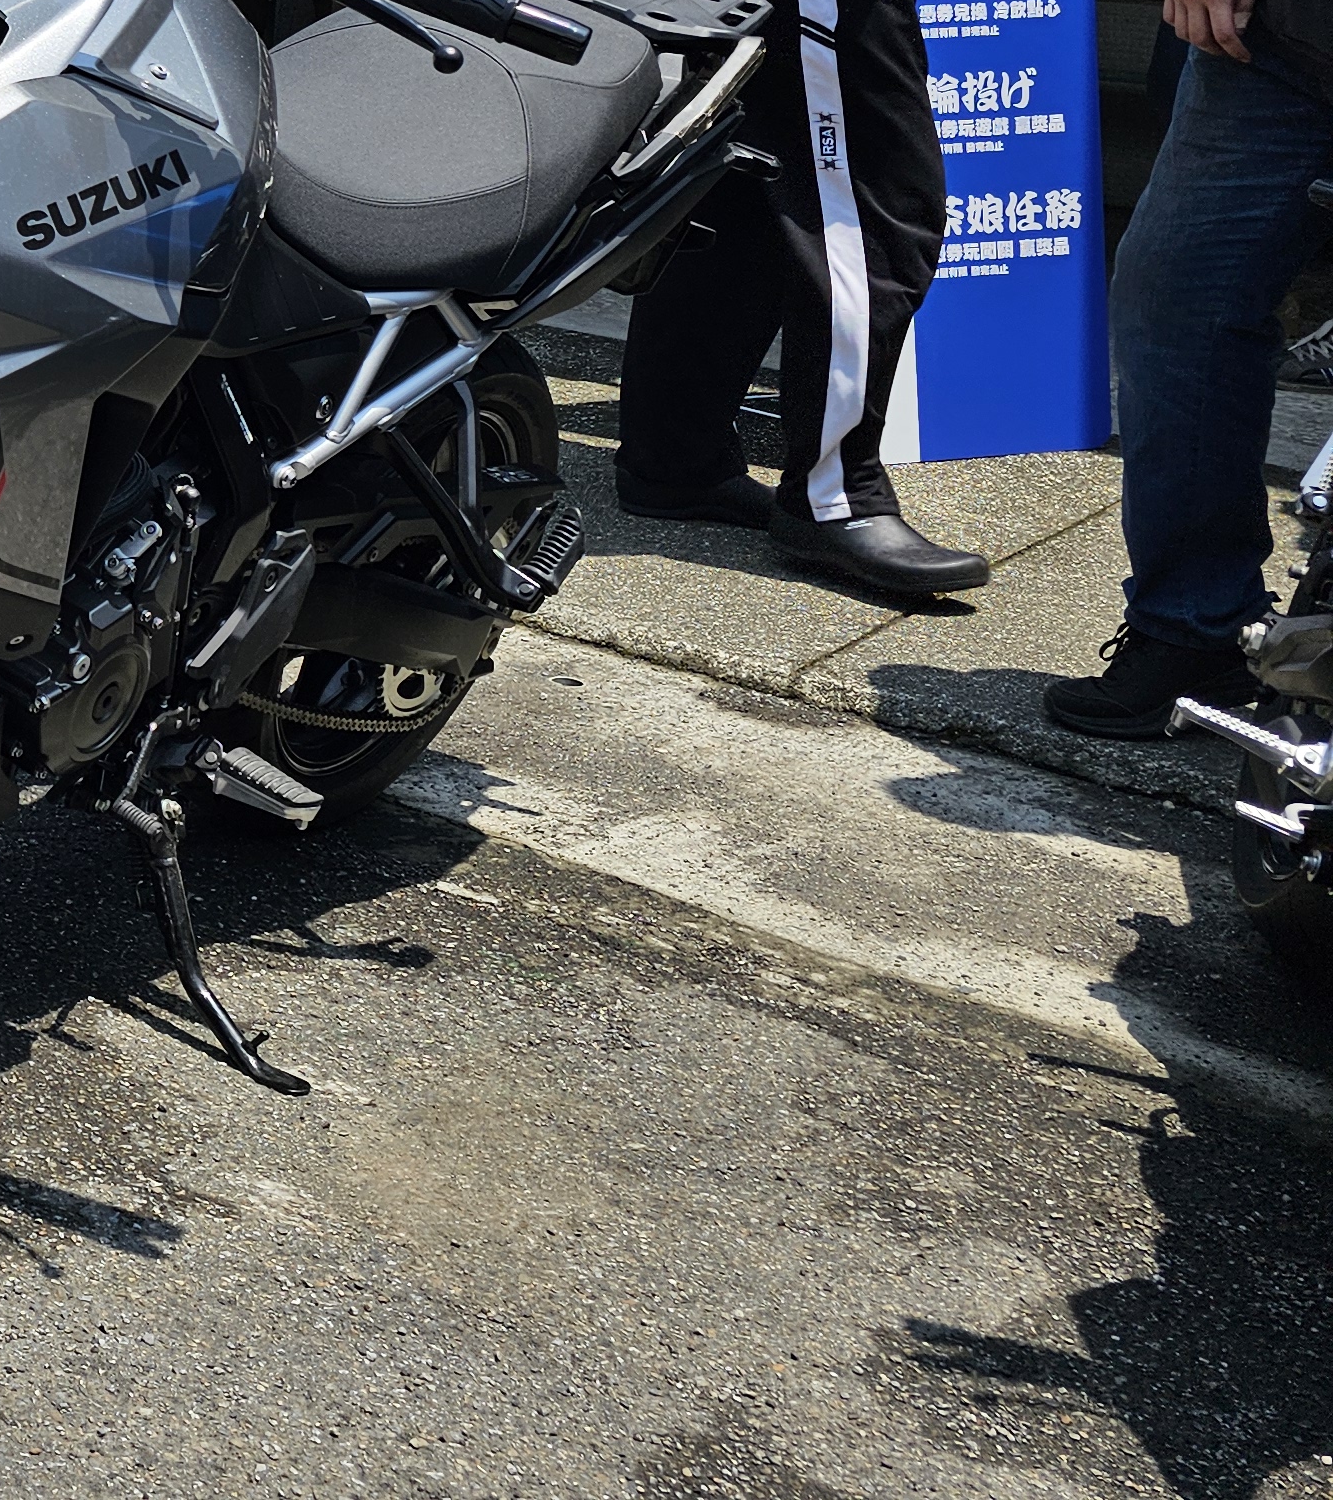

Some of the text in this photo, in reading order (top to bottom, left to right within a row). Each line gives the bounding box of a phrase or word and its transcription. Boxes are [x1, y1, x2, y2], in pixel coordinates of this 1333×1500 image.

[926, 67, 1037, 114] 輪投げ
[822, 129, 835, 154] RSA
[934, 117, 1010, 138] 券玩遊戲
[16, 149, 191, 250] SUZUKI
